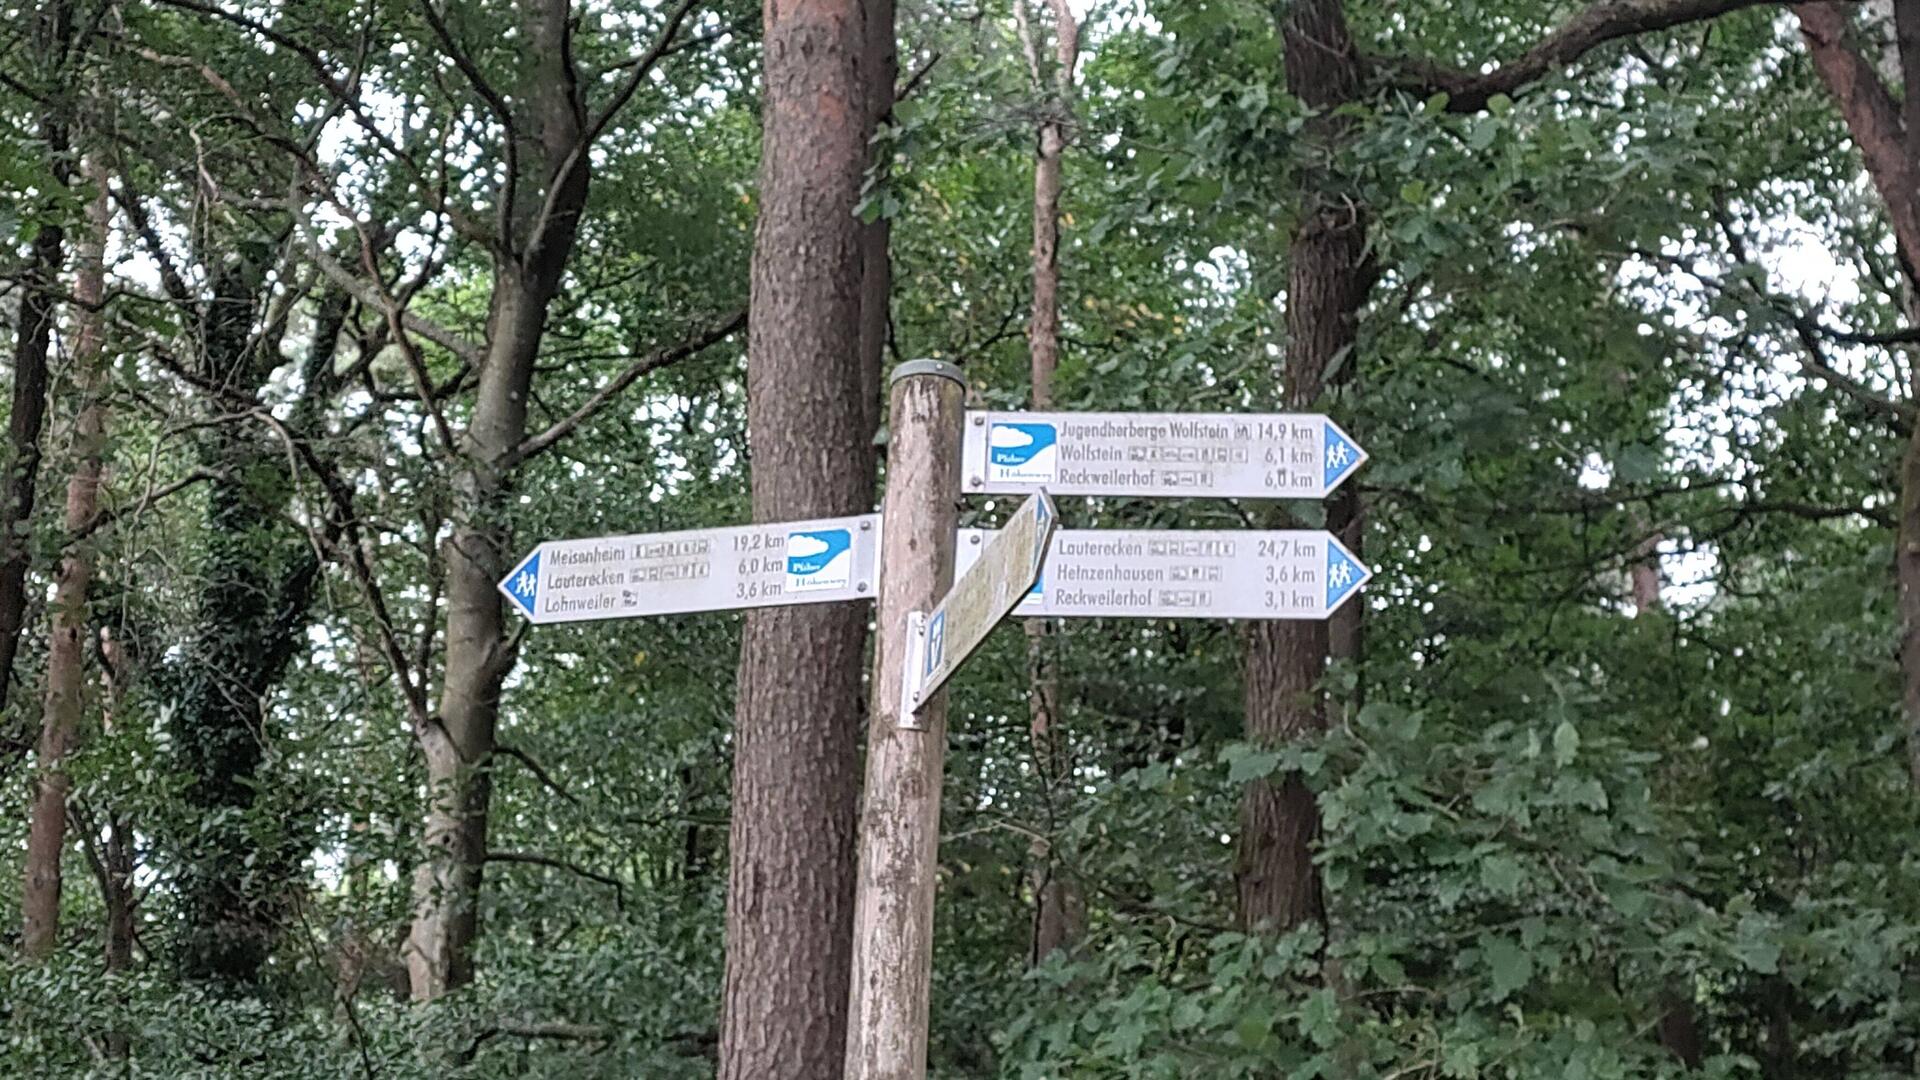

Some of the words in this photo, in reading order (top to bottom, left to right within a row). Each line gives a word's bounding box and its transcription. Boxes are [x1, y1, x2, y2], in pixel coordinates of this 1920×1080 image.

[1060, 421, 1167, 441] Jugendherberge
[1169, 421, 1229, 438] Wolfstein
[1258, 422, 1287, 441] 14,9
[1291, 422, 1313, 439] km
[1060, 444, 1122, 461] Wolfstein
[1264, 448, 1285, 465] 6,1
[1291, 447, 1313, 463] km
[1060, 467, 1155, 485] Reckweilerhof
[1264, 471, 1287, 488] 6,0
[1291, 470, 1313, 487] km
[549, 546, 625, 566] Meisenheim
[732, 534, 761, 552] 19,2
[764, 533, 785, 549] km
[1058, 539, 1142, 556] Lauterecken
[1257, 540, 1289, 559] 24,7
[1293, 539, 1316, 557] km
[547, 569, 625, 590] Lauterecken
[738, 557, 759, 577] 6,0
[762, 556, 783, 573] km
[1056, 563, 1164, 582] Heinzenhausen
[1265, 566, 1288, 585] 3,6
[1292, 565, 1316, 582] km
[544, 593, 617, 613] Lohnweiler
[736, 581, 757, 600] 3,6
[761, 580, 782, 596] km
[1055, 588, 1153, 606] Reckweilerhof
[1264, 591, 1286, 609] 3,1
[1292, 590, 1315, 607] km
